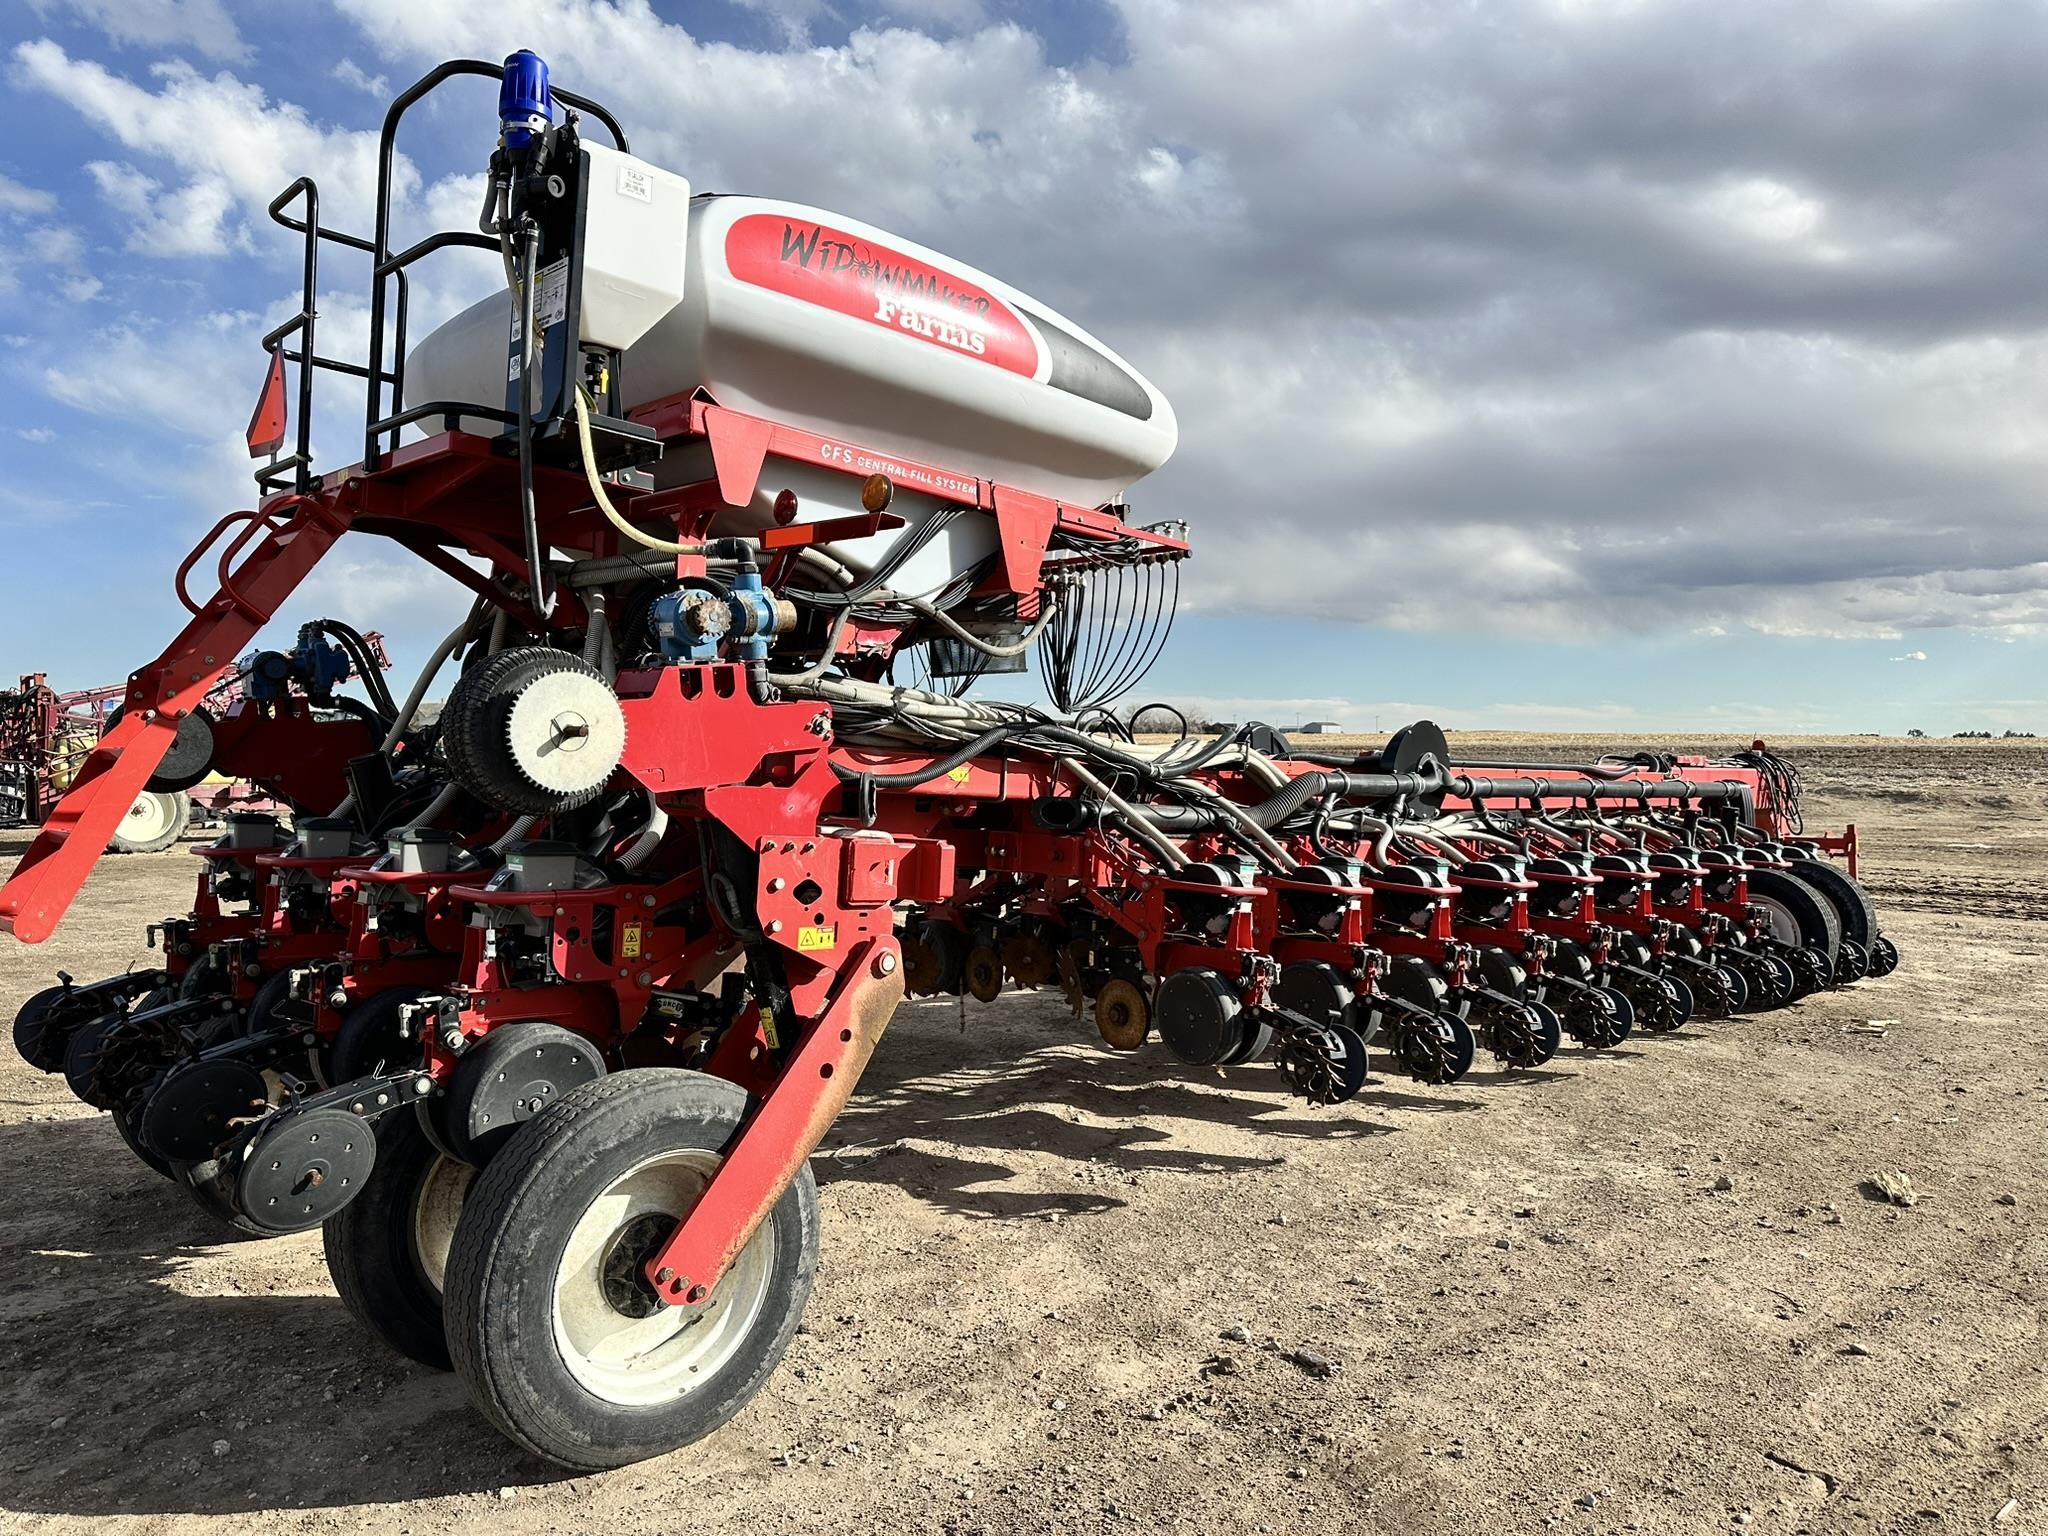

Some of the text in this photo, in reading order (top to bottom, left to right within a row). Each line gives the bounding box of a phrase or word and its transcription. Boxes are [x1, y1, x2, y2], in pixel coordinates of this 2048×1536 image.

[874, 290, 987, 355] Farms
[820, 443, 978, 495] CFS CENTRAL FILL SYSTEM
